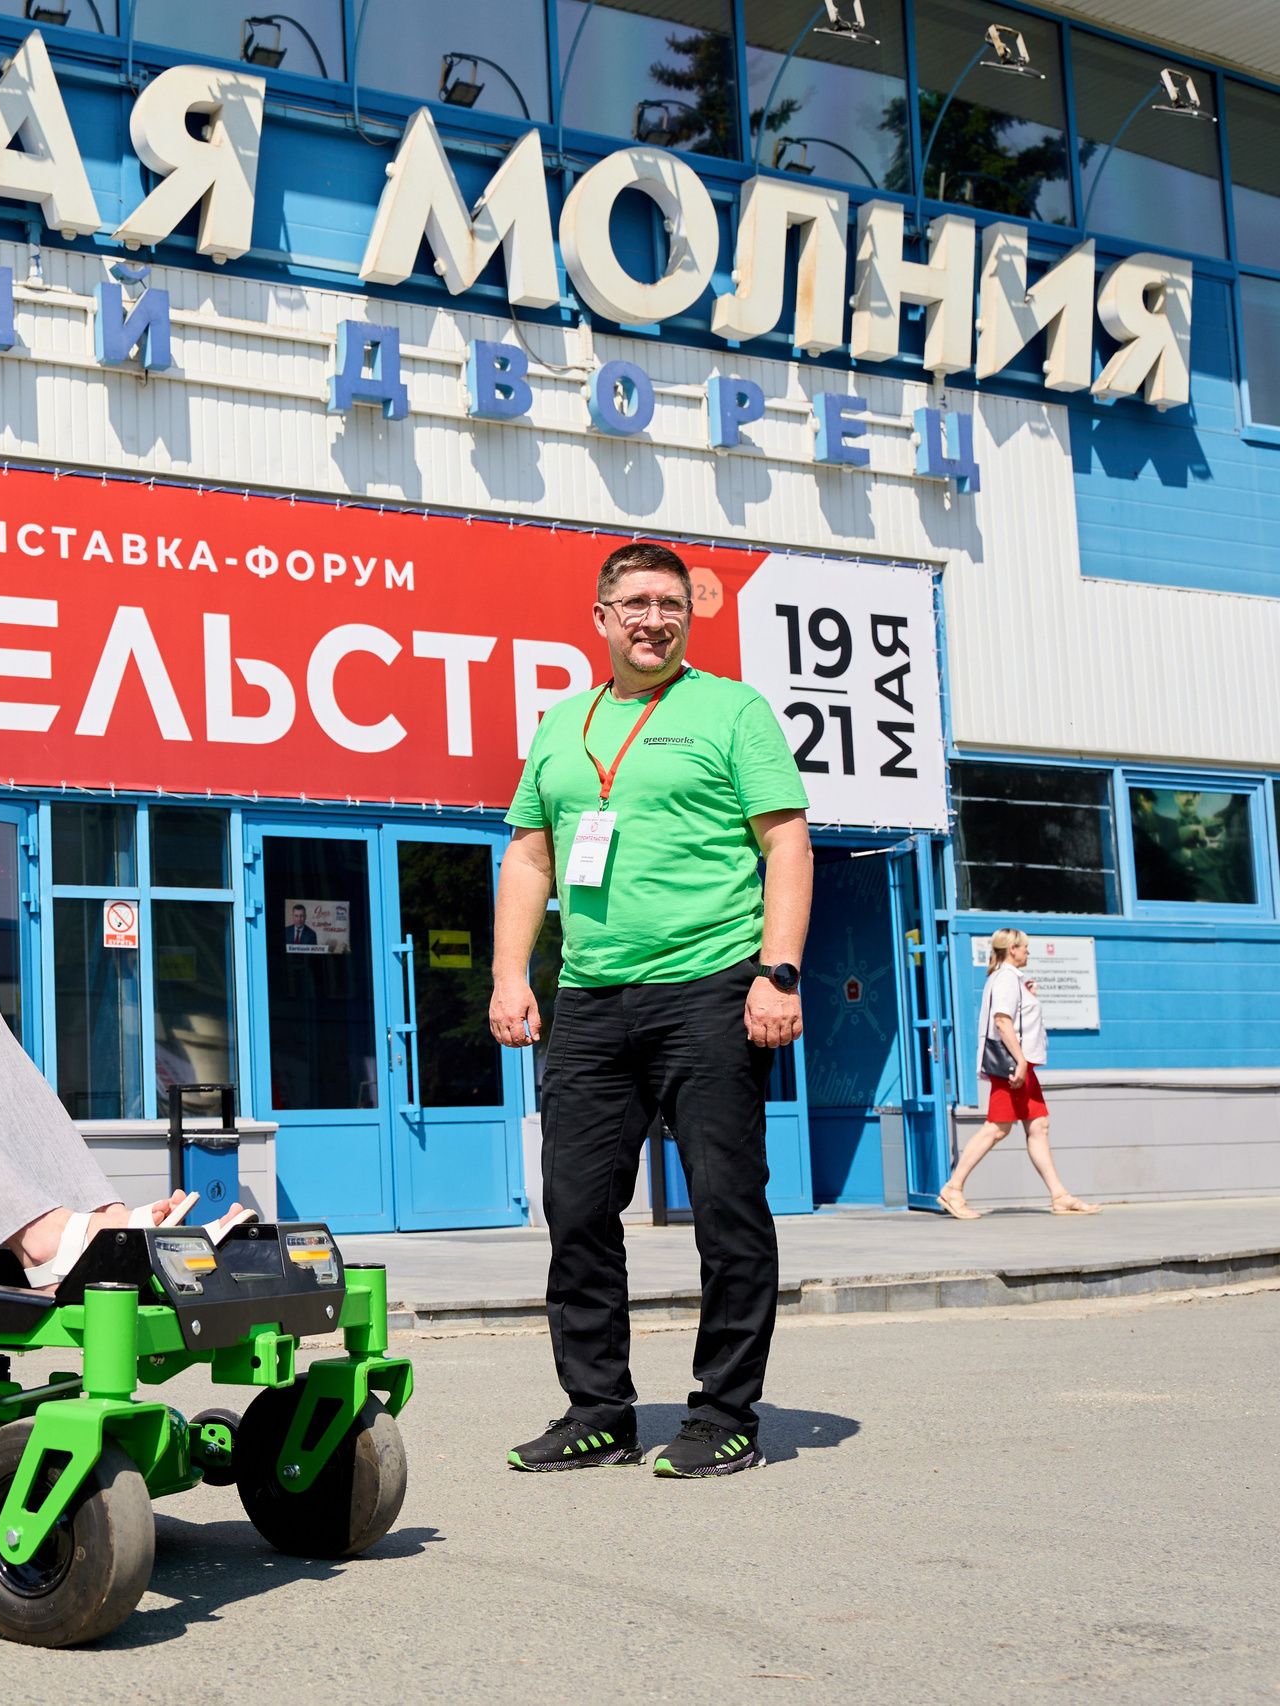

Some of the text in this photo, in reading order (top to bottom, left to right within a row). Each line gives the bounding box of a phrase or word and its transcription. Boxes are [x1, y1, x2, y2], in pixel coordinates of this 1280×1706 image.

[358, 105, 1194, 409] МОЛНИЯ
[326, 318, 981, 494] ДВОРЕЦ
[775, 603, 853, 679] 19
[870, 613, 918, 779] МАЯ
[643, 736, 695, 745] greenworks
[783, 701, 856, 776] 21
